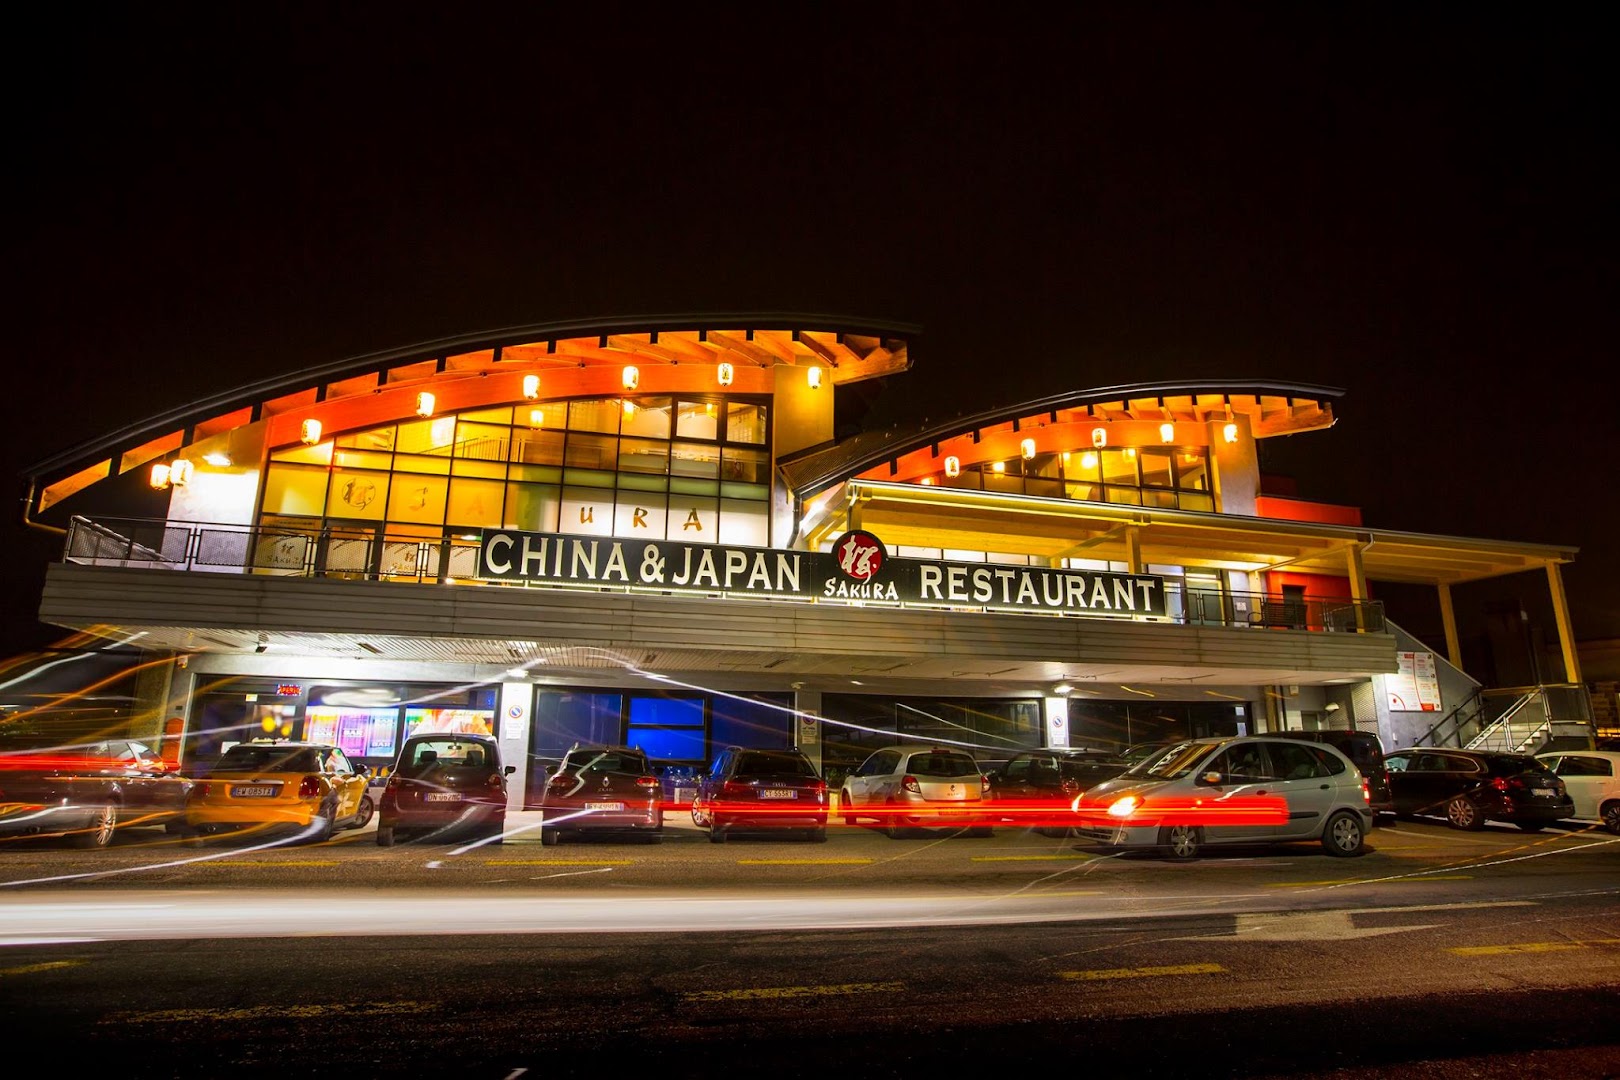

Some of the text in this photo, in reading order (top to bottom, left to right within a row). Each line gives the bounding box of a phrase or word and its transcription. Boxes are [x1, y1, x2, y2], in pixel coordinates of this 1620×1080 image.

[485, 534, 801, 591] CHINA & JAPAN
[823, 576, 899, 601] SAKURA
[919, 564, 1155, 612] RESTAURANT
